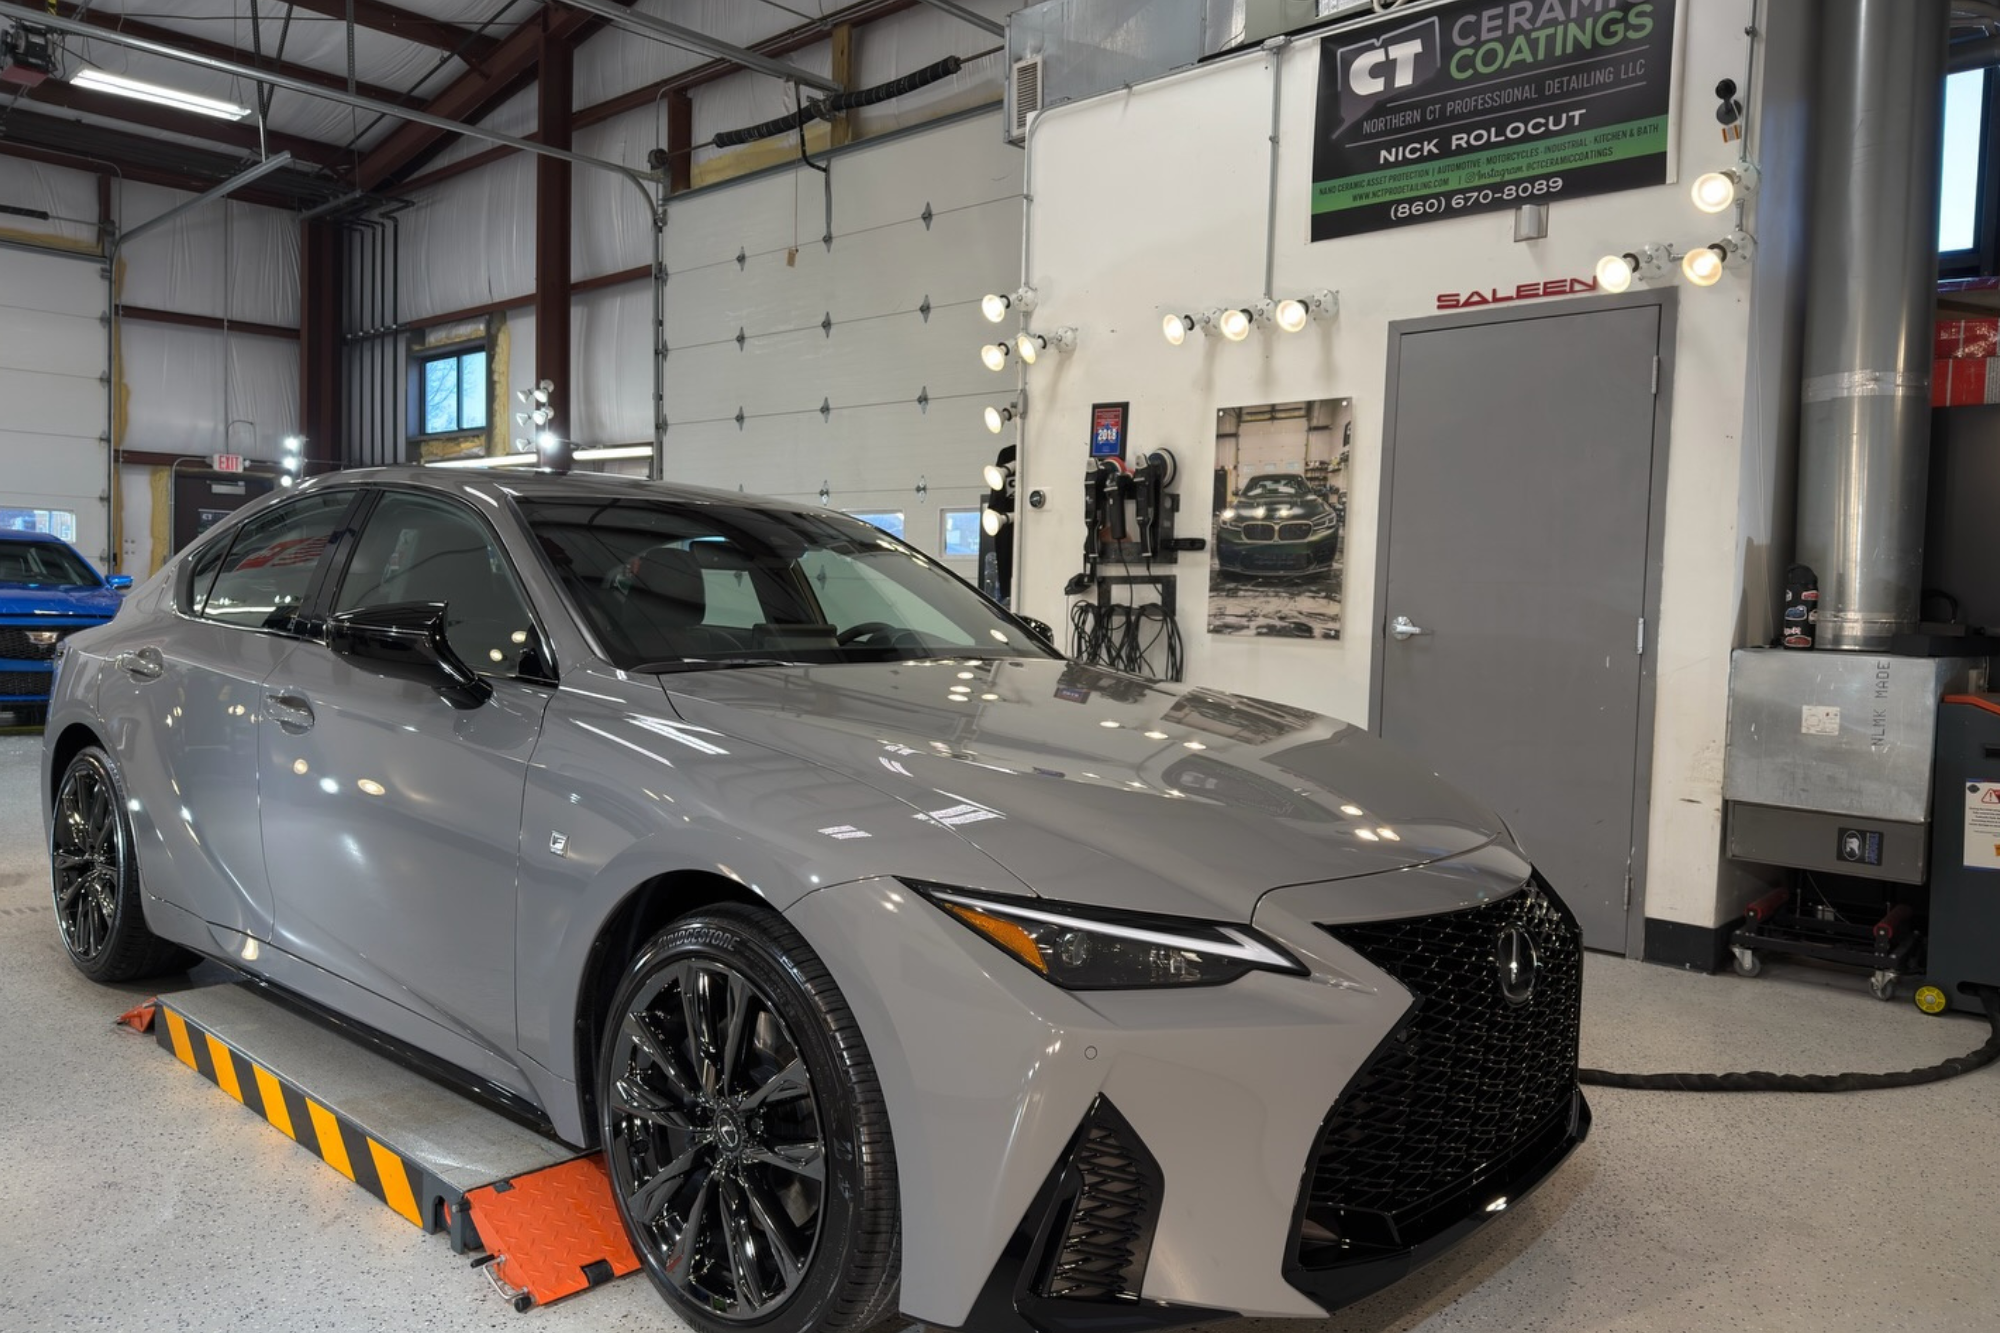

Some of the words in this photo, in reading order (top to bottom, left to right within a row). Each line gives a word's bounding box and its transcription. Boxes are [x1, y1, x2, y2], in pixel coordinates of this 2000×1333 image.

[1450, 4, 1654, 80] COATINGS
[1452, 0, 1647, 46] CERAM
[1349, 38, 1423, 96] CT
[1362, 108, 1422, 135] NORTHERN
[1426, 104, 1442, 121] CT
[1446, 83, 1539, 117] PROFESSIONAL
[1544, 66, 1614, 96] DETAILING
[1620, 59, 1646, 79] LLC
[1379, 138, 1441, 165] NICK
[1451, 108, 1587, 151] ROLOCUT
[1319, 186, 1336, 196] NANO
[1337, 179, 1366, 193] CERAMIC
[1366, 175, 1388, 187] ASSET
[1388, 169, 1430, 184] PROTECTION
[1436, 158, 1482, 175] AUTOMOTIVE
[1485, 147, 1540, 166] MOTORCYCLES
[1543, 137, 1589, 155] INDUSTRIAL
[1593, 129, 1628, 145] KITCHEN
[1628, 128, 1636, 138] &
[1637, 124, 1660, 137] BATH
[1351, 176, 1451, 203] WWW.NCTPRODETAILING.COM
[1476, 165, 1524, 182] Instagram
[1389, 196, 1447, 220] (860)
[1450, 177, 1564, 209] 670-8089
[1436, 275, 1598, 310] SALEEN
[218, 455, 239, 471] EXIT
[1875, 661, 1891, 699] MADE
[1871, 708, 1887, 747] NLMK
[657, 928, 741, 953] BRIDGESTONE
